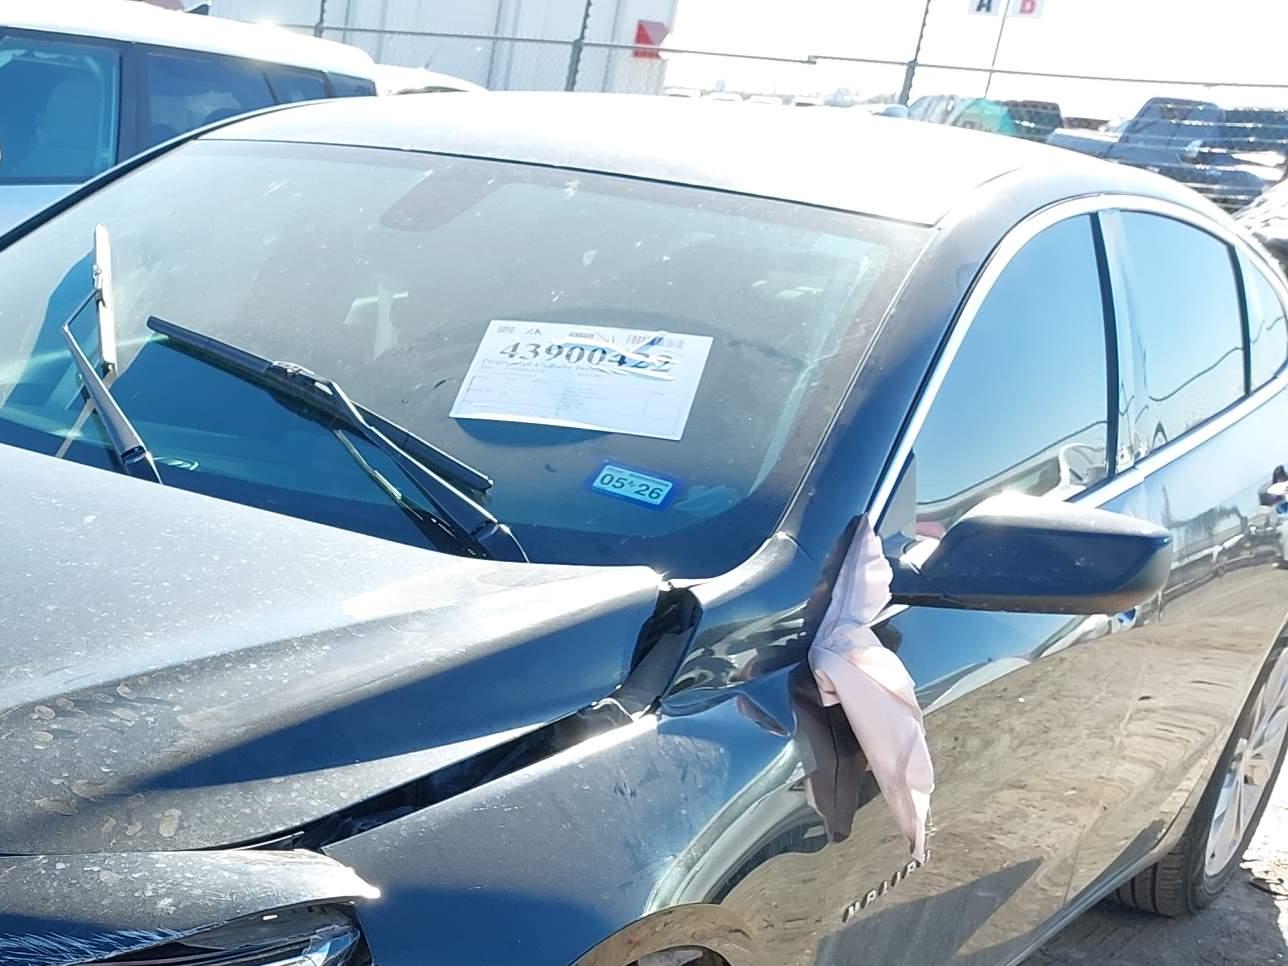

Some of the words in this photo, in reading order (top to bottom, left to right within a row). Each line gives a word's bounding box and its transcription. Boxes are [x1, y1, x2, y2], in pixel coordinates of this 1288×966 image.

[499, 341, 674, 373] 43900422
[599, 473, 628, 489] 05
[633, 483, 664, 500] 26
